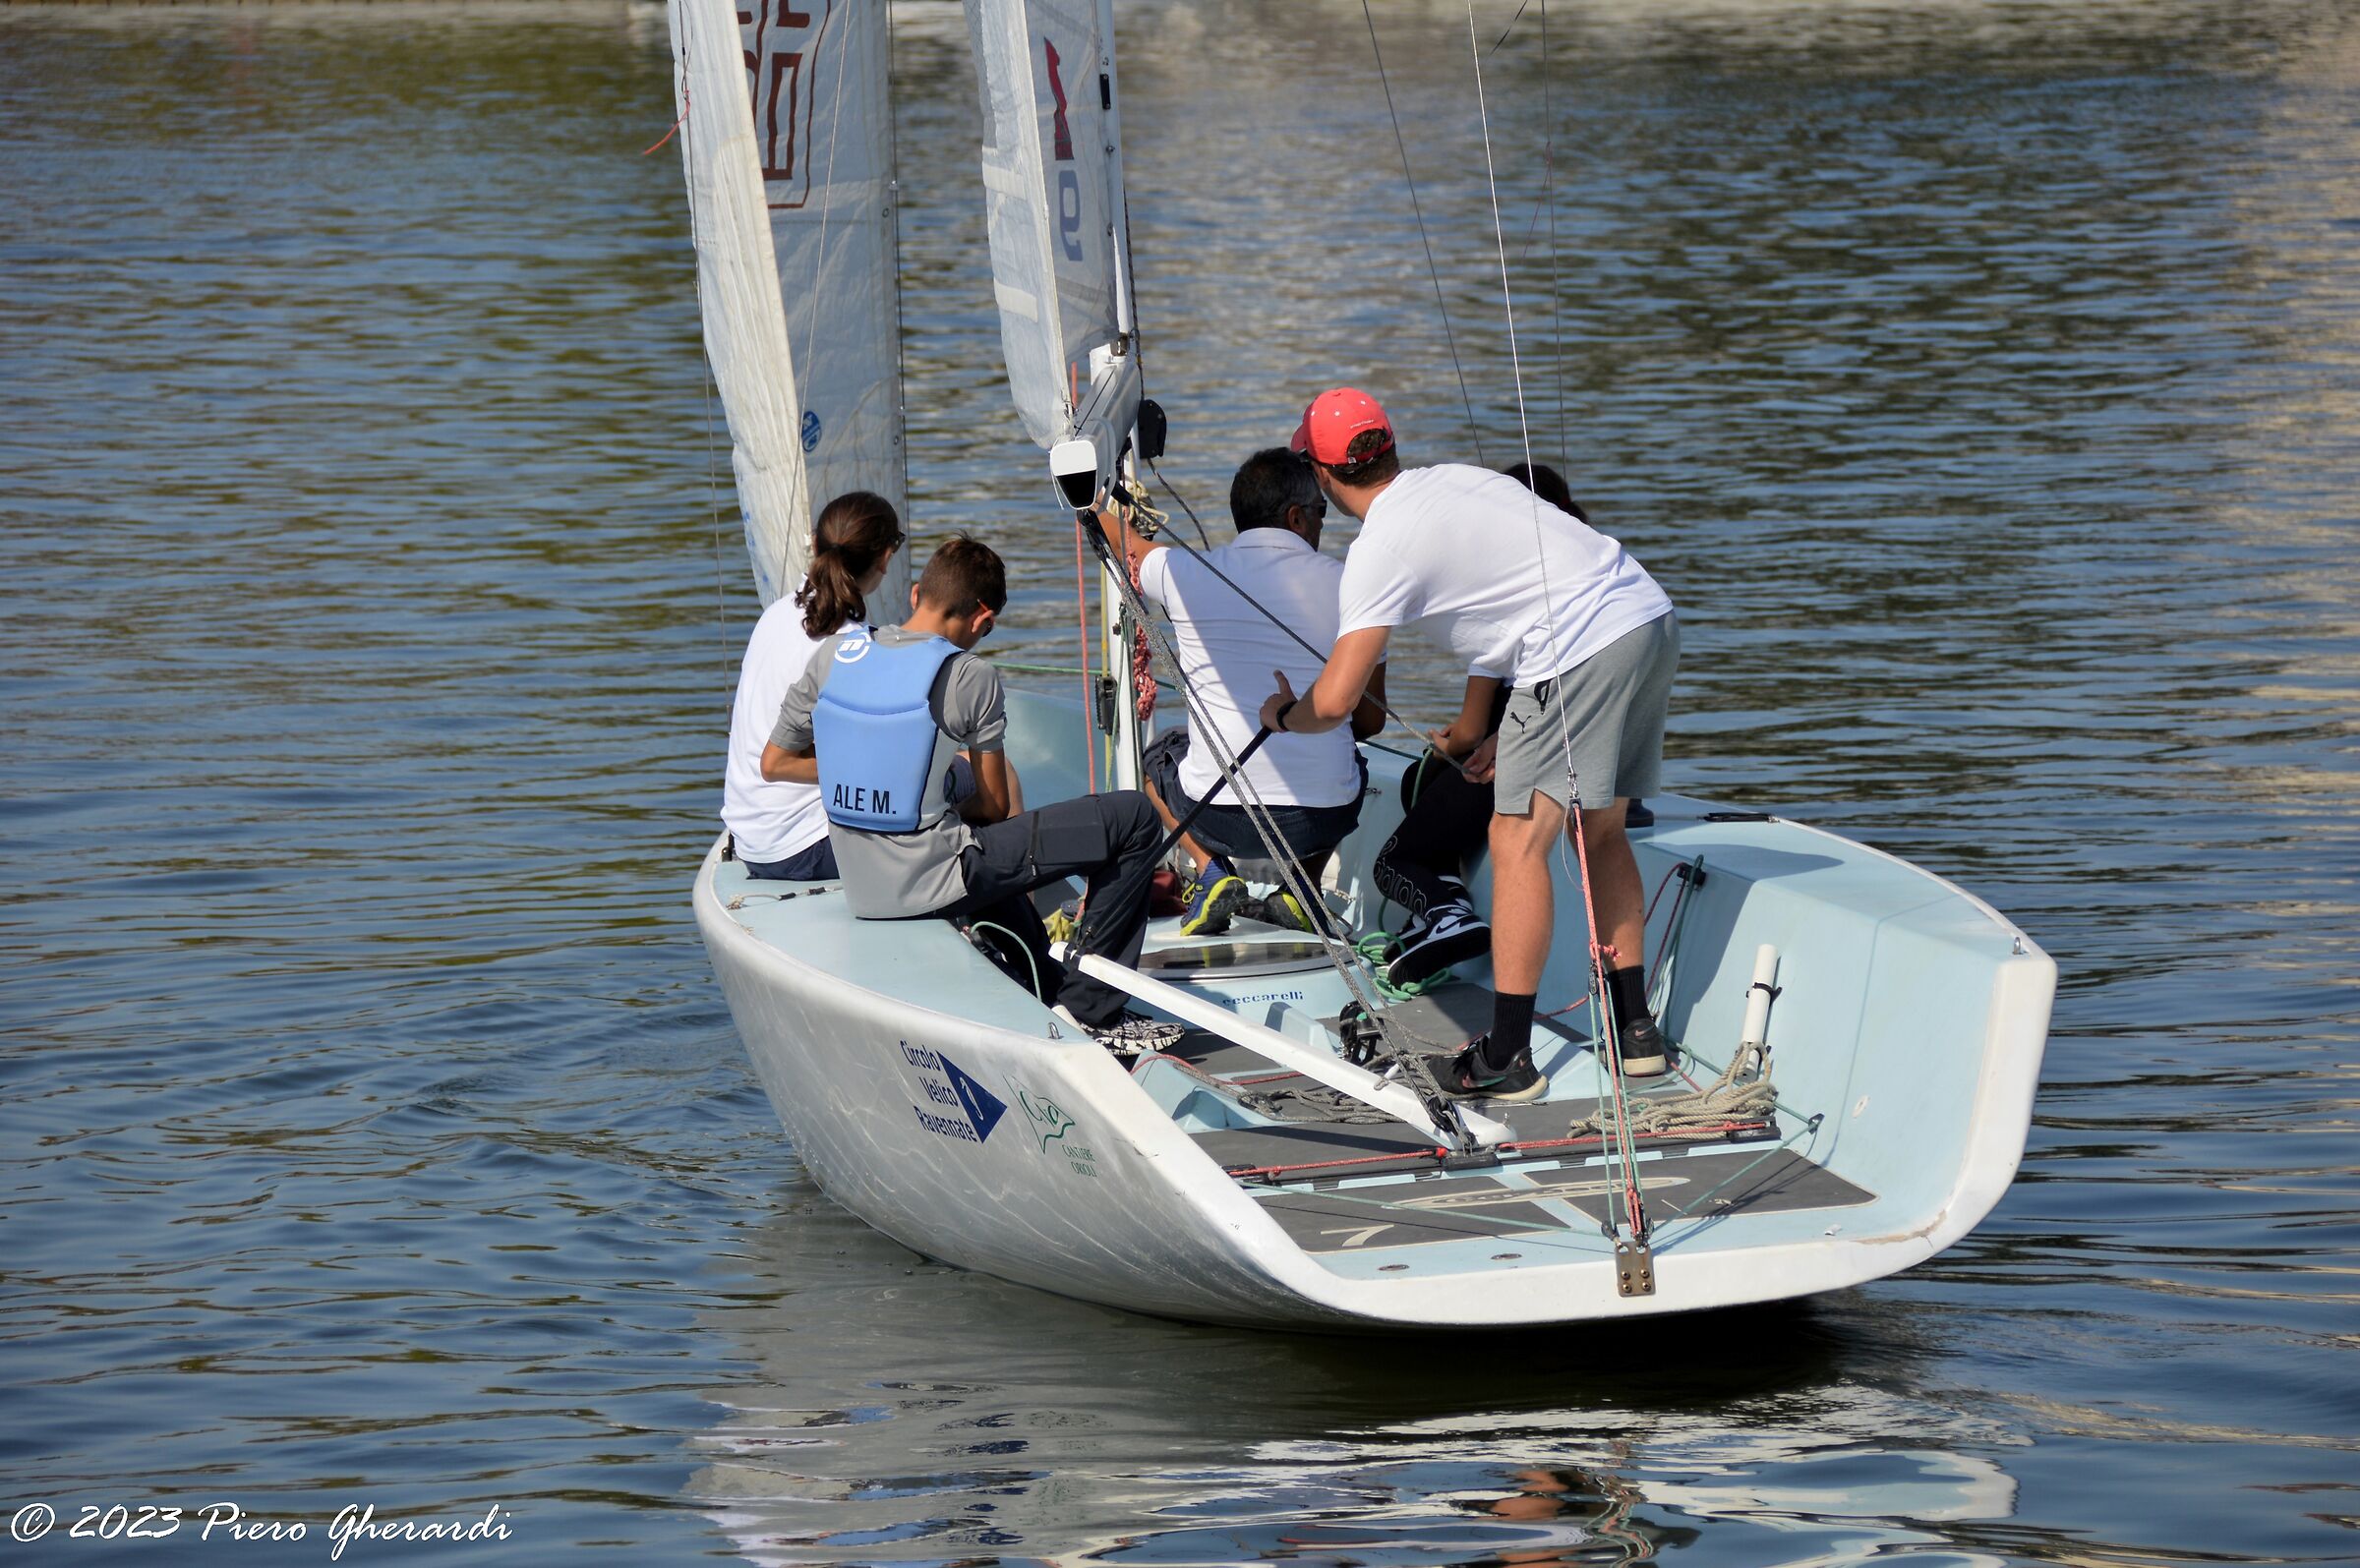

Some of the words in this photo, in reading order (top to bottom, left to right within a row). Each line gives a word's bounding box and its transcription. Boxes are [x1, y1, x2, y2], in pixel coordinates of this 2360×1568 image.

[833, 784, 865, 812] ALE
[872, 789, 897, 815] M.
[900, 1040, 941, 1072] Circolo
[918, 1076, 959, 1107] Velico
[914, 1105, 978, 1142] Ravennate
[1062, 1144, 1095, 1162] CANTIERE
